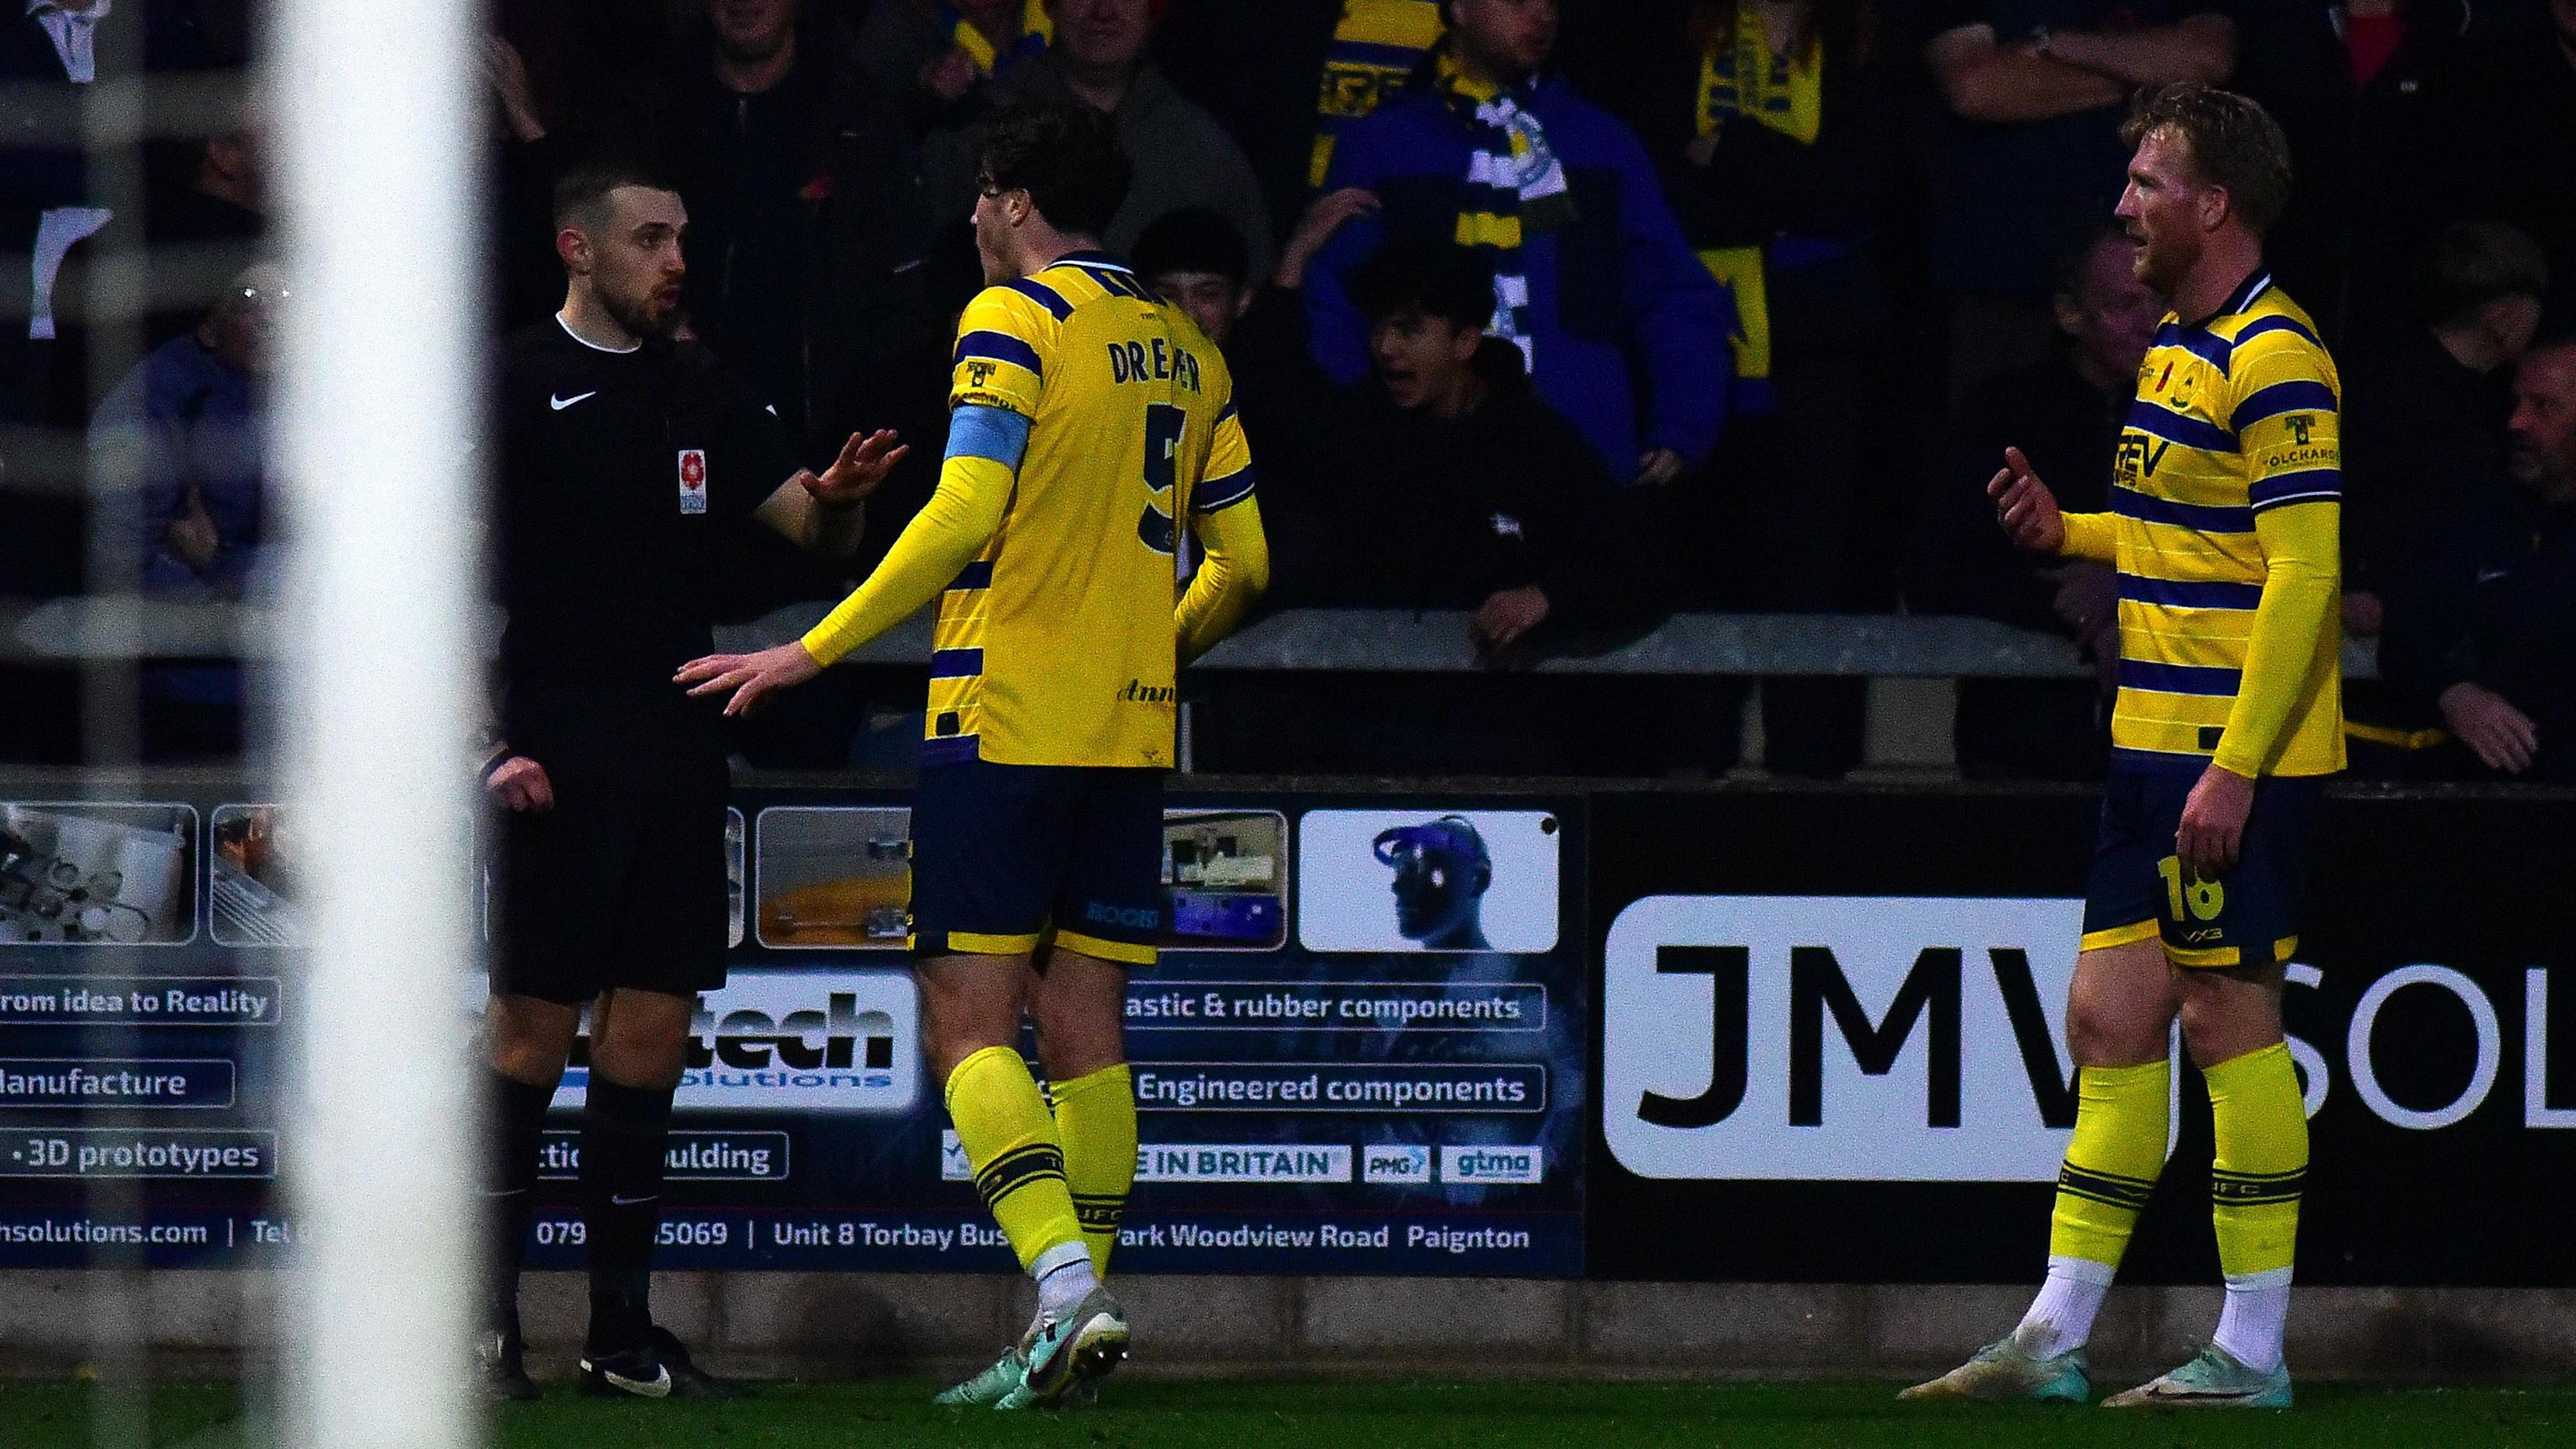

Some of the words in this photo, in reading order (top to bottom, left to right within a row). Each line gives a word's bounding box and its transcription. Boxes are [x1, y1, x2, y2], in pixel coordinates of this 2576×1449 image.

[1137, 401, 1187, 555] 5
[0, 994, 56, 1013] rom
[64, 989, 123, 1013] idea
[131, 991, 160, 1013] to
[166, 989, 268, 1019] Reality
[1126, 993, 1195, 1018] astic
[1204, 994, 1226, 1017] &
[1234, 994, 1332, 1018] rubber
[1340, 996, 1521, 1024] components
[684, 992, 894, 1069] tech
[679, 1073, 894, 1087] olutions
[1138, 1073, 1318, 1107] Engineered
[1326, 1076, 1526, 1108] components
[78, 1141, 260, 1174] prototypes
[664, 1141, 772, 1175] ulding
[1158, 1150, 1189, 1175] IN
[1197, 1150, 1330, 1175] BRITAIN
[1457, 1149, 1530, 1177] gtma
[537, 1220, 588, 1246] 079
[653, 1220, 729, 1246] 5069
[773, 1222, 832, 1246] Unit
[838, 1222, 855, 1246] 8
[859, 1221, 954, 1252] Torbay
[959, 1223, 1009, 1246] Bus
[1116, 1224, 1166, 1248] ark
[1171, 1224, 1315, 1248] Woodview
[1320, 1224, 1390, 1248] Road
[1407, 1224, 1531, 1254] Paignton
